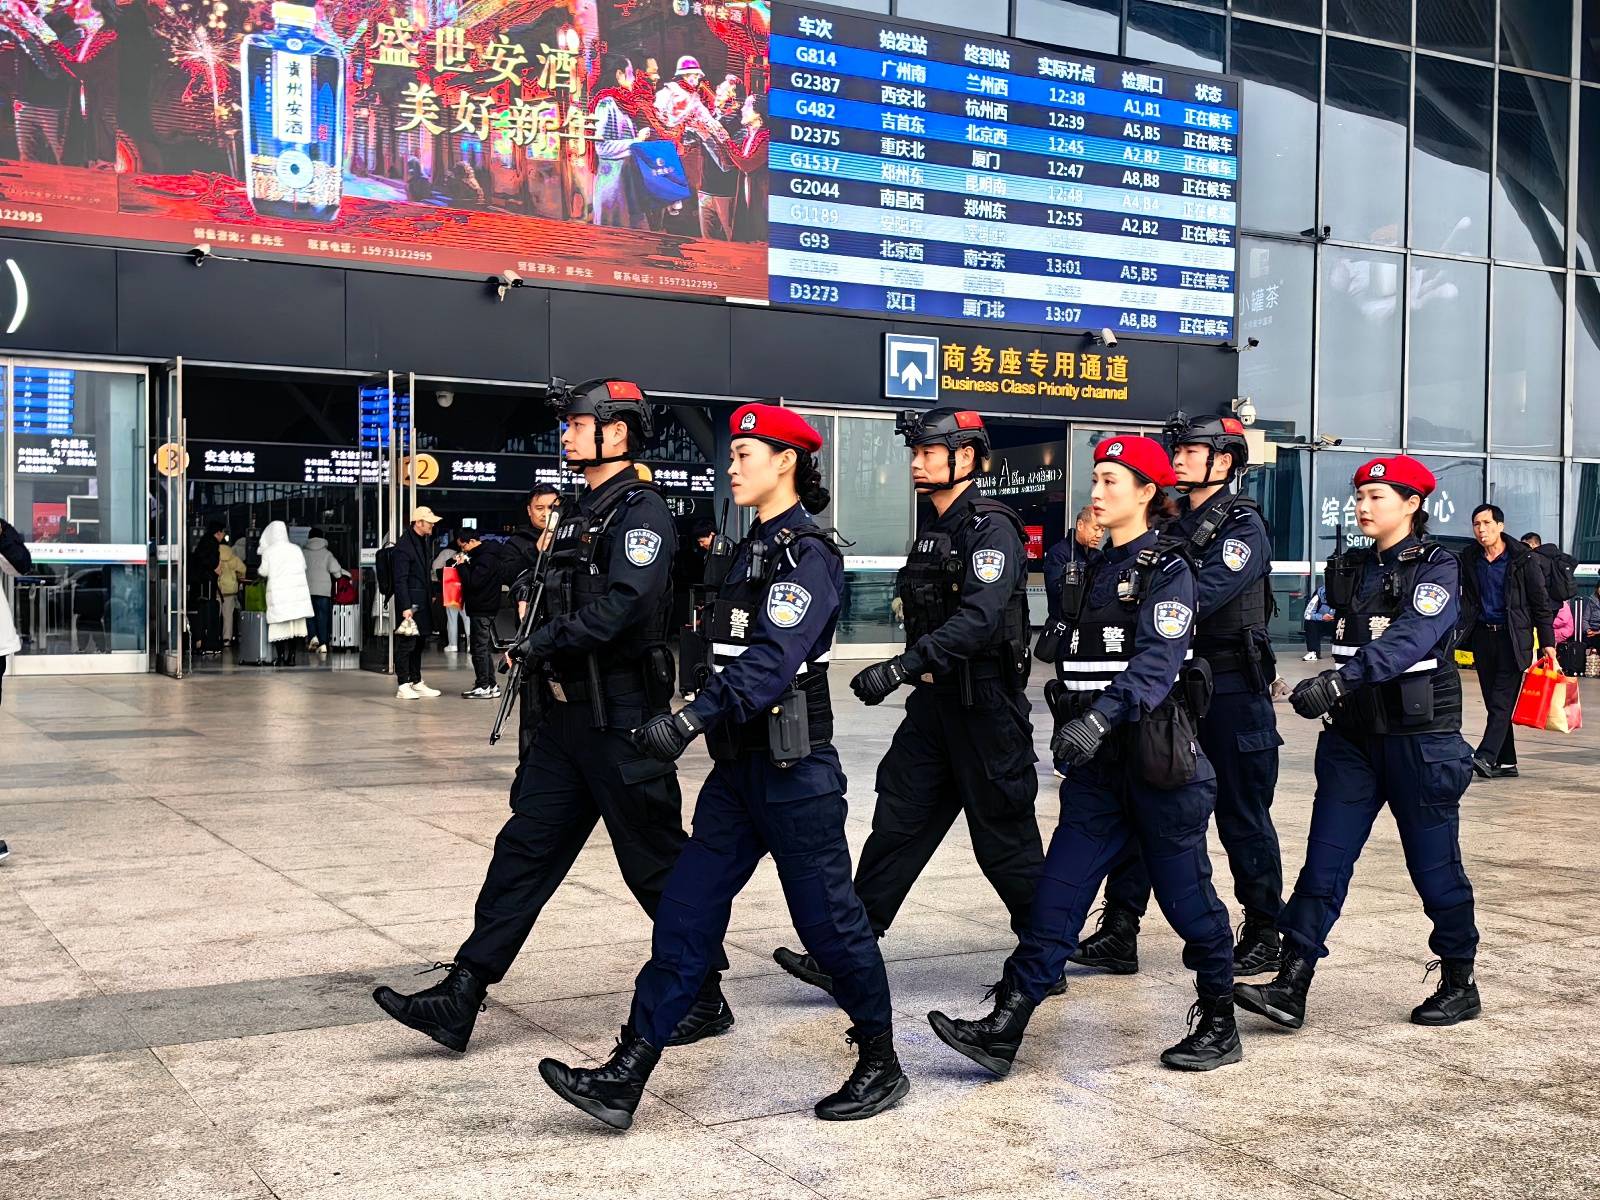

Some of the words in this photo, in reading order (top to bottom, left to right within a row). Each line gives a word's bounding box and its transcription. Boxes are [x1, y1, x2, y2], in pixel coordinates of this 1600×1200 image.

[369, 17, 580, 93] 盛世安酒
[798, 15, 833, 40] 车次
[879, 29, 928, 56] 始发站
[964, 43, 1011, 70] 终到站
[1038, 57, 1096, 83] 实际开点
[1122, 70, 1163, 95] 检票口
[1194, 83, 1223, 104] 状态
[795, 46, 837, 67] G814
[881, 60, 926, 84] 广州南
[966, 73, 1009, 96] 兰州西
[1050, 87, 1085, 106] 12:38
[1123, 98, 1161, 118] A1,B1
[1184, 108, 1233, 131] 正在候车
[394, 82, 604, 156] 美好新年
[790, 72, 841, 94] G2387
[881, 85, 926, 109] 西安北
[965, 98, 1009, 122] 杭州西
[1049, 112, 1085, 130] 12:39
[1122, 122, 1161, 141] A5,B5
[1183, 131, 1232, 154] 正在候车
[795, 99, 836, 119] G482
[881, 111, 926, 134] 吉首东
[966, 124, 1008, 146] 北京西
[1049, 136, 1084, 154] 12:45
[1123, 146, 1160, 165] A2,B2
[1183, 154, 1232, 176] 正在候车
[790, 124, 841, 146] D2375
[880, 136, 926, 160] 重庆北
[971, 149, 1001, 170] 厦门
[1047, 160, 1085, 179] 12:47
[1122, 170, 1160, 189] A8,B8
[1182, 177, 1232, 200] 正在候车
[790, 178, 841, 199] G2044
[880, 188, 925, 211] 南昌西
[964, 198, 1007, 220] 郑州东
[1047, 209, 1083, 227] 12:55
[1121, 217, 1159, 236] A2,B2
[1181, 224, 1231, 246] 正在候车
[799, 231, 830, 249] G93
[880, 240, 924, 262] 北京西
[963, 249, 1006, 270] 南宁东
[1046, 258, 1082, 276] 13:01
[1120, 265, 1158, 283] A5,B5
[1180, 270, 1230, 292] 正在候车
[790, 282, 839, 302] D3273
[886, 291, 916, 311] 汉口
[962, 298, 1005, 319] 厦门北
[1045, 306, 1082, 323] 13:07
[1119, 312, 1157, 330] A8,B8
[1179, 316, 1229, 337] 正在候车
[941, 342, 1129, 383] 商务座专用通道
[941, 375, 999, 394] Business
[1000, 379, 1036, 395] Class
[1038, 382, 1079, 401] Priority
[1080, 385, 1128, 401] channel
[165, 448, 178, 471] 3
[204, 449, 255, 464] 安全检查
[417, 459, 429, 480] 2
[451, 460, 497, 474] 安全检查
[654, 469, 688, 480] 安全检查
[729, 607, 750, 639] 警
[1102, 626, 1125, 653] 警
[1368, 615, 1391, 641] 警
